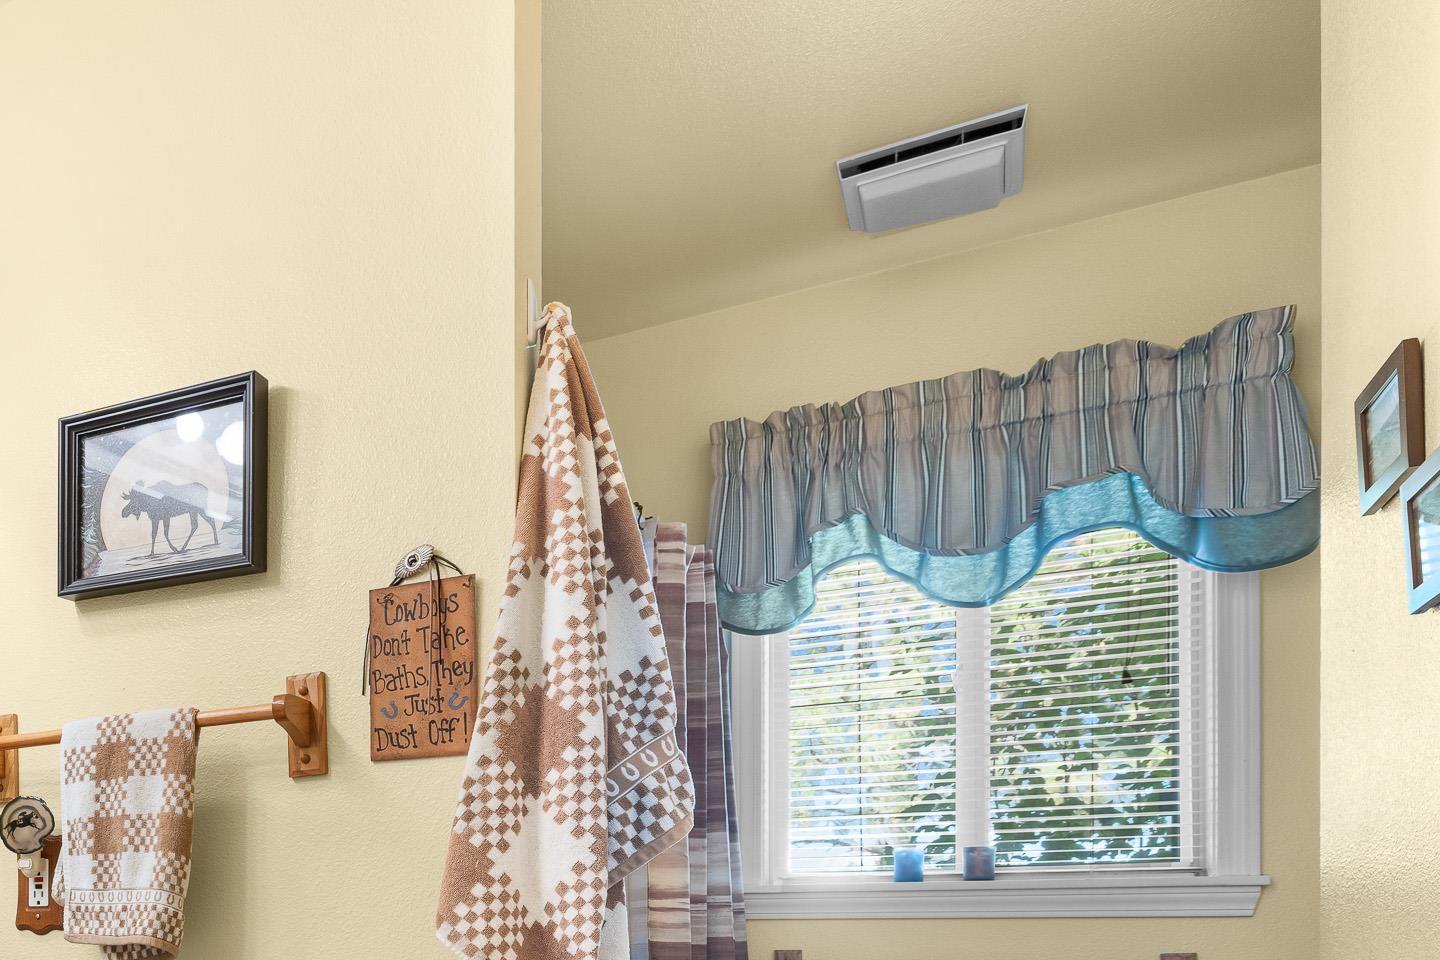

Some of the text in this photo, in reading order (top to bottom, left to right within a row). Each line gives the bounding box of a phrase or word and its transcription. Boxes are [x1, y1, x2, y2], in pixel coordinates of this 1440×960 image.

[416, 625, 469, 654] Take
[431, 657, 474, 686] They
[404, 687, 445, 717] Just
[374, 724, 419, 753] Dust
